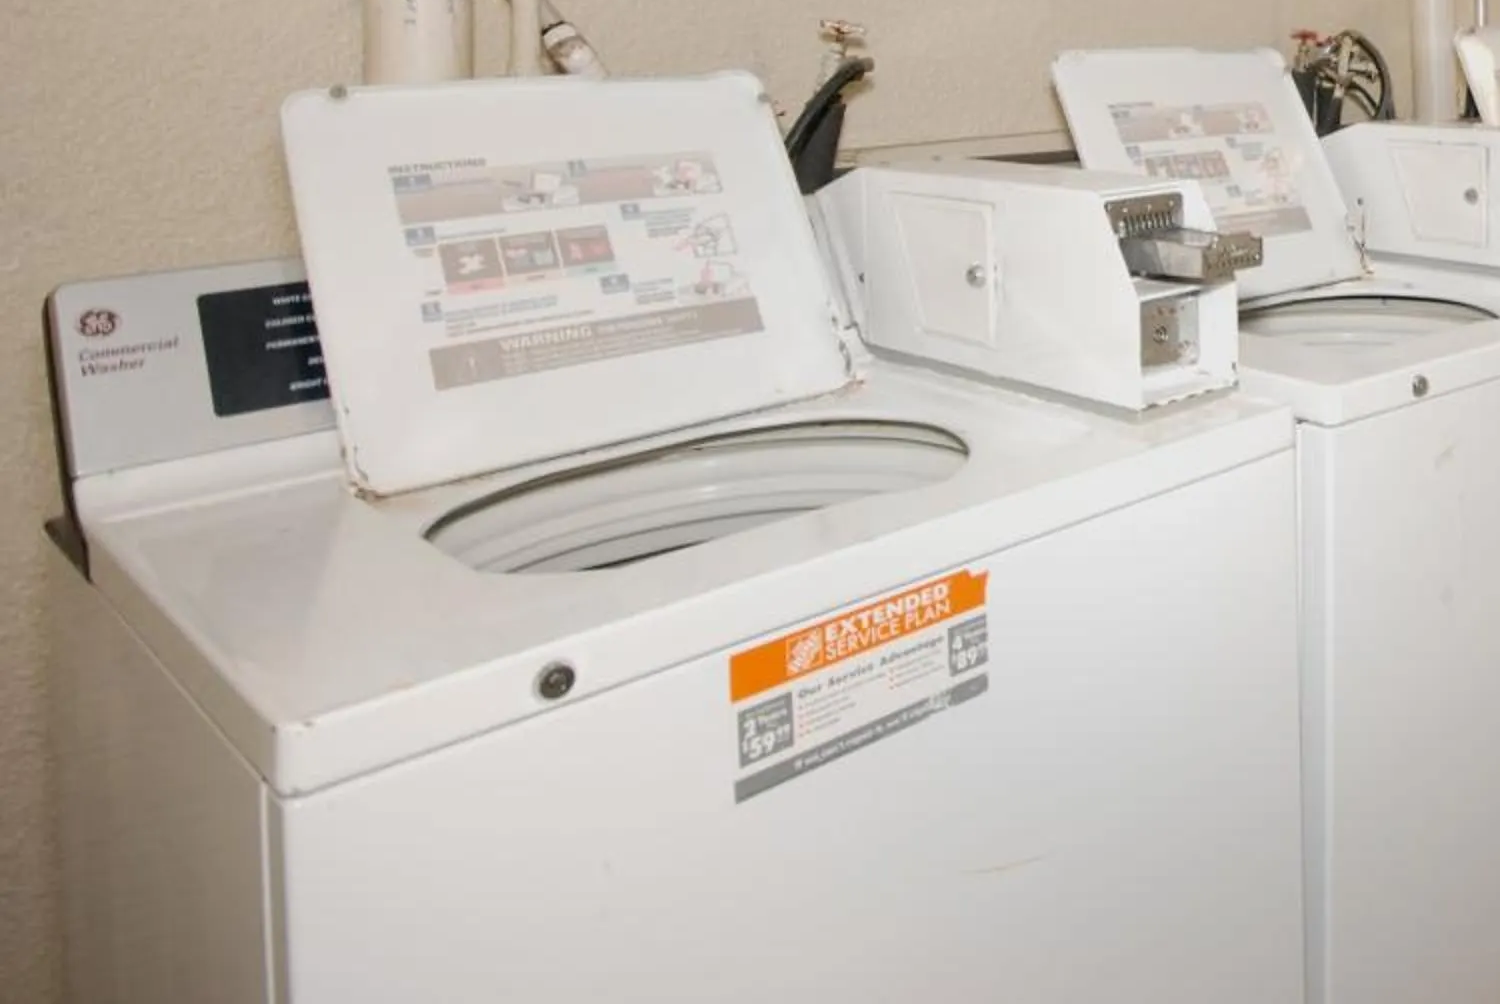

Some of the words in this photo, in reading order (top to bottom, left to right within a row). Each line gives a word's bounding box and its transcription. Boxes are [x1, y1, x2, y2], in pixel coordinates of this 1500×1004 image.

[77, 336, 180, 363] Commercial
[500, 325, 593, 352] WARNING
[80, 357, 145, 378] Washer
[824, 583, 949, 642] EXTENDED
[825, 617, 900, 661] SERVICE
[905, 598, 951, 630] PLAN
